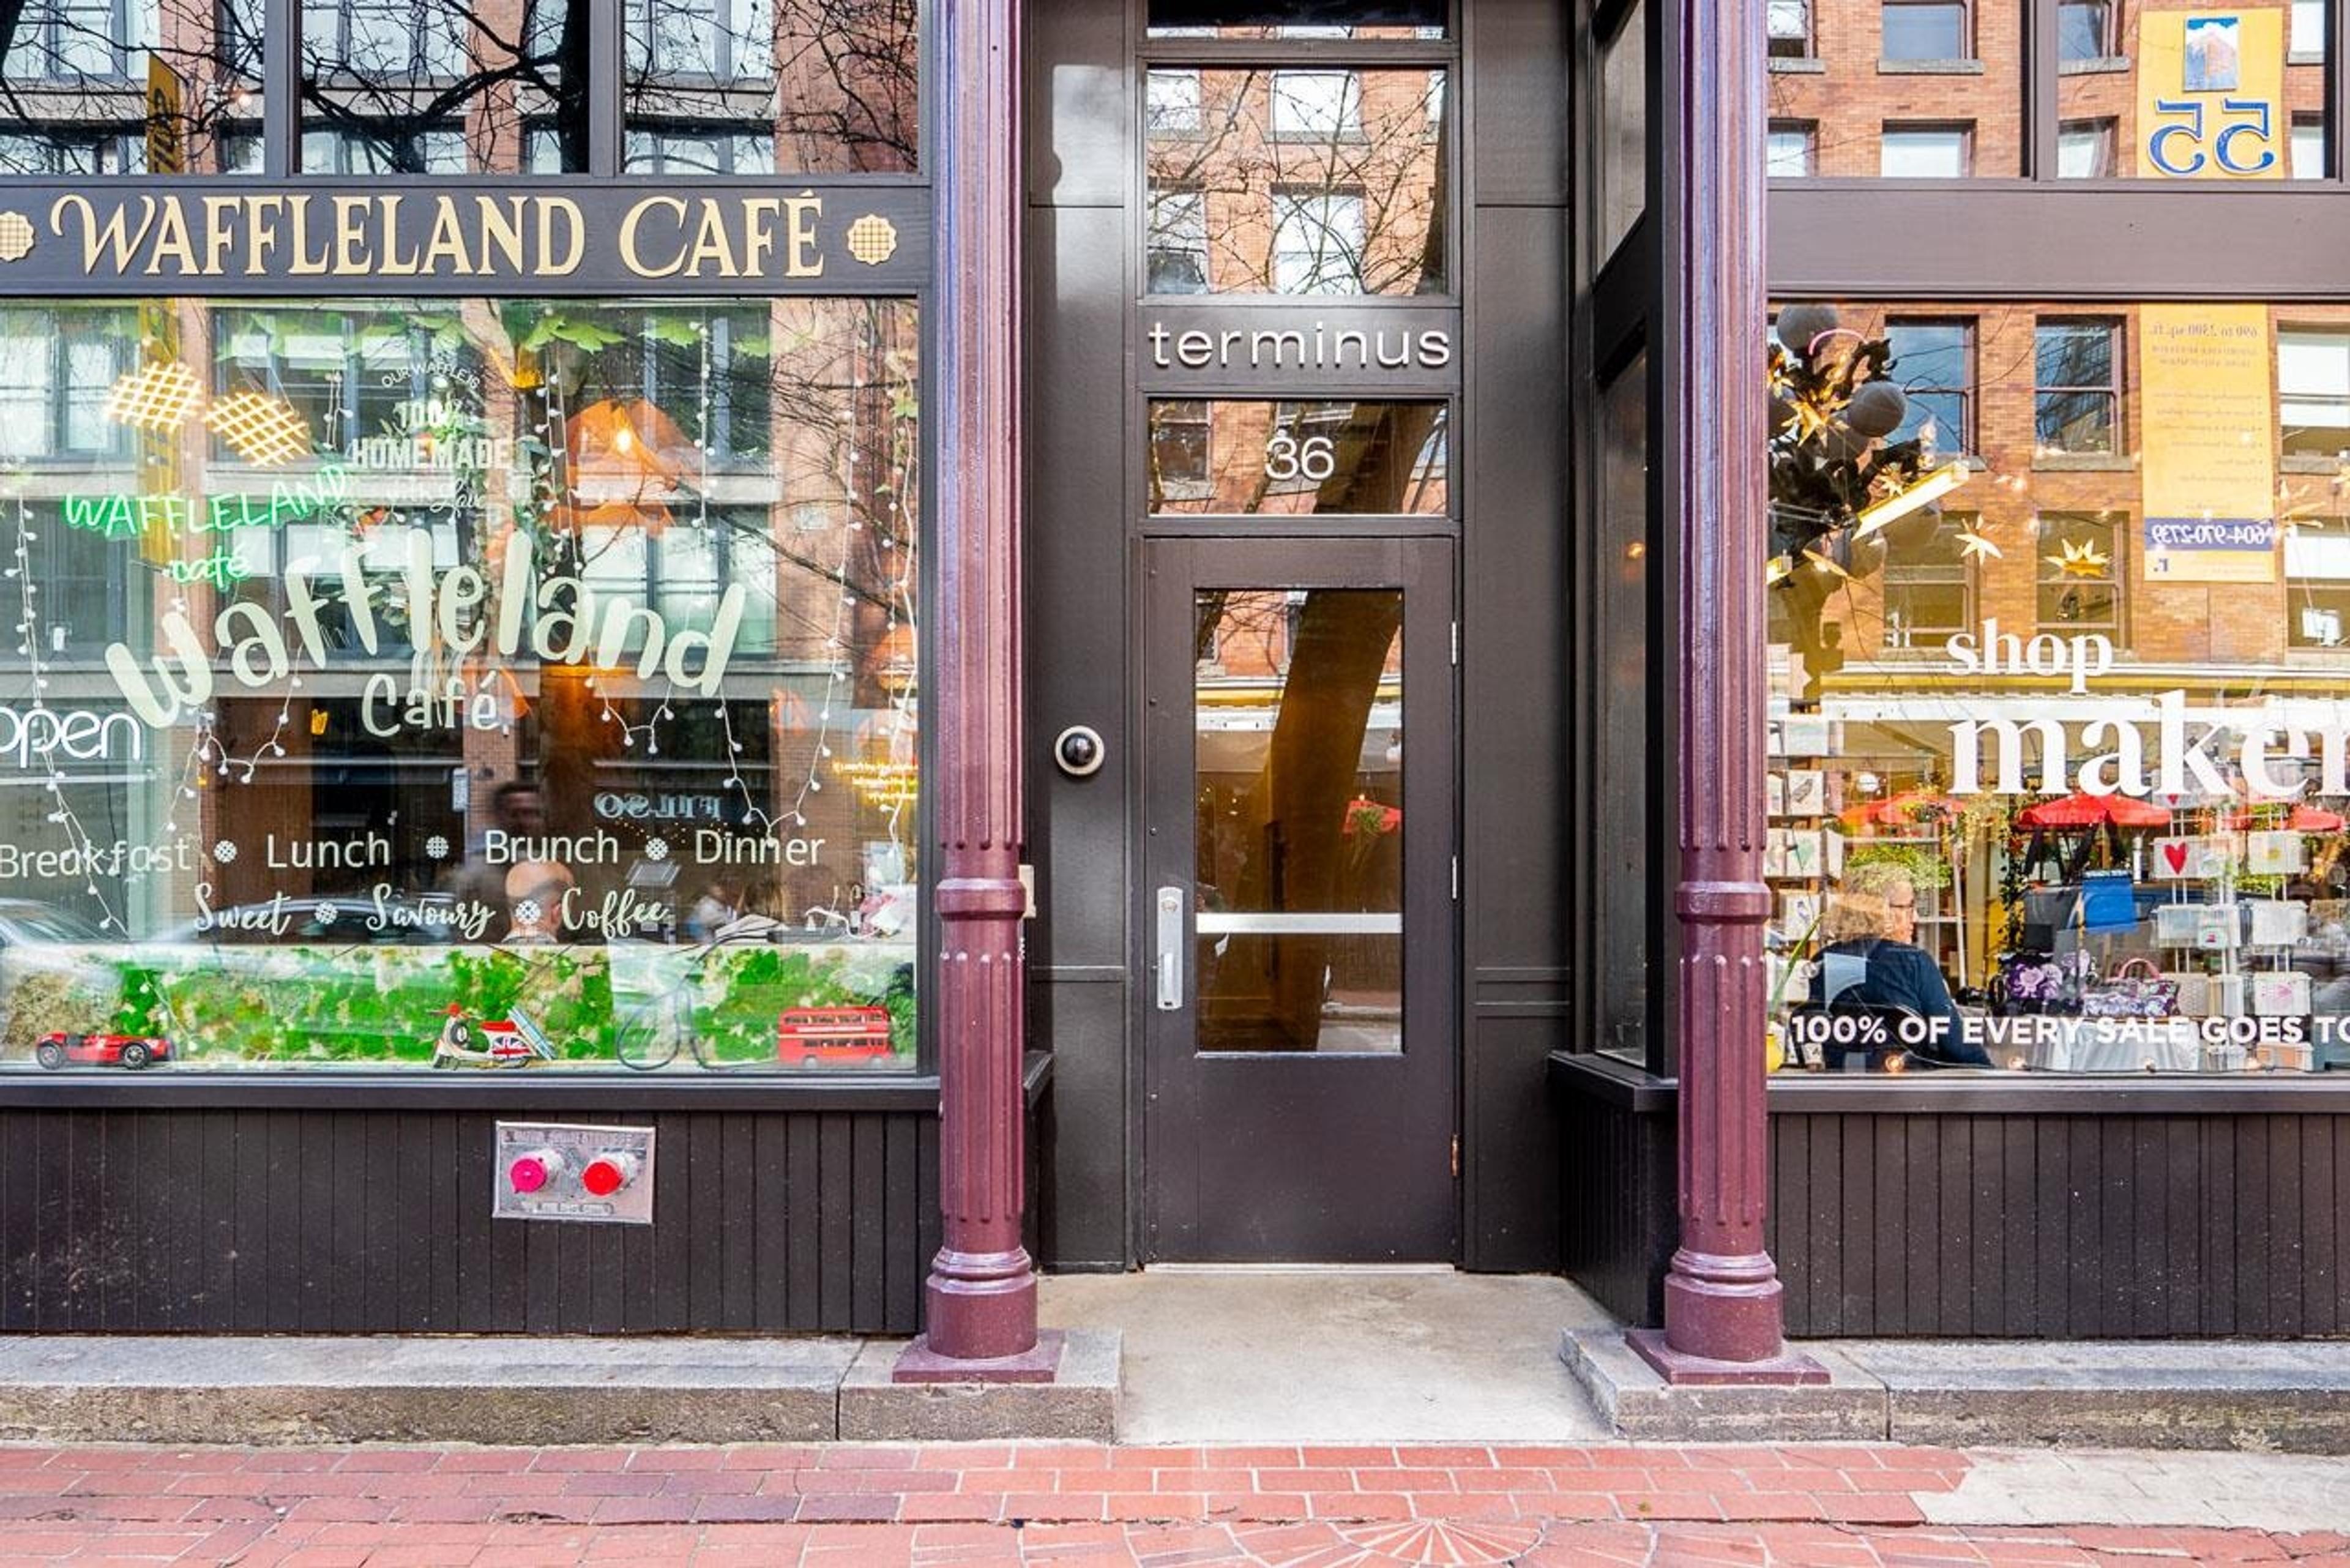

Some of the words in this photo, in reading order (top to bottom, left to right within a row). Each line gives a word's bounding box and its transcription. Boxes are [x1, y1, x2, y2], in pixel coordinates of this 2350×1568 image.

[50, 193, 586, 276] WAFFLELAND
[619, 189, 824, 279] CAFÉ
[1147, 321, 1450, 367] terminus
[381, 367, 411, 389] OUR
[352, 437, 515, 470] HOMEMADE
[1265, 436, 1335, 480] 36
[65, 464, 348, 539] WAFFLELAND
[1947, 617, 2114, 694] shop
[362, 670, 501, 737] Café
[267, 832, 390, 868] Lunch
[485, 829, 618, 864] Brunch
[695, 828, 825, 865] Dinner
[194, 882, 292, 935] Sweet
[561, 887, 672, 939] Coffee
[1792, 1015, 1887, 1044] 100%
[1898, 1015, 1951, 1044] OF
[1963, 1015, 2084, 1044] EVERY
[2097, 1015, 2190, 1044] SALE
[2201, 1015, 2303, 1044] GOES
